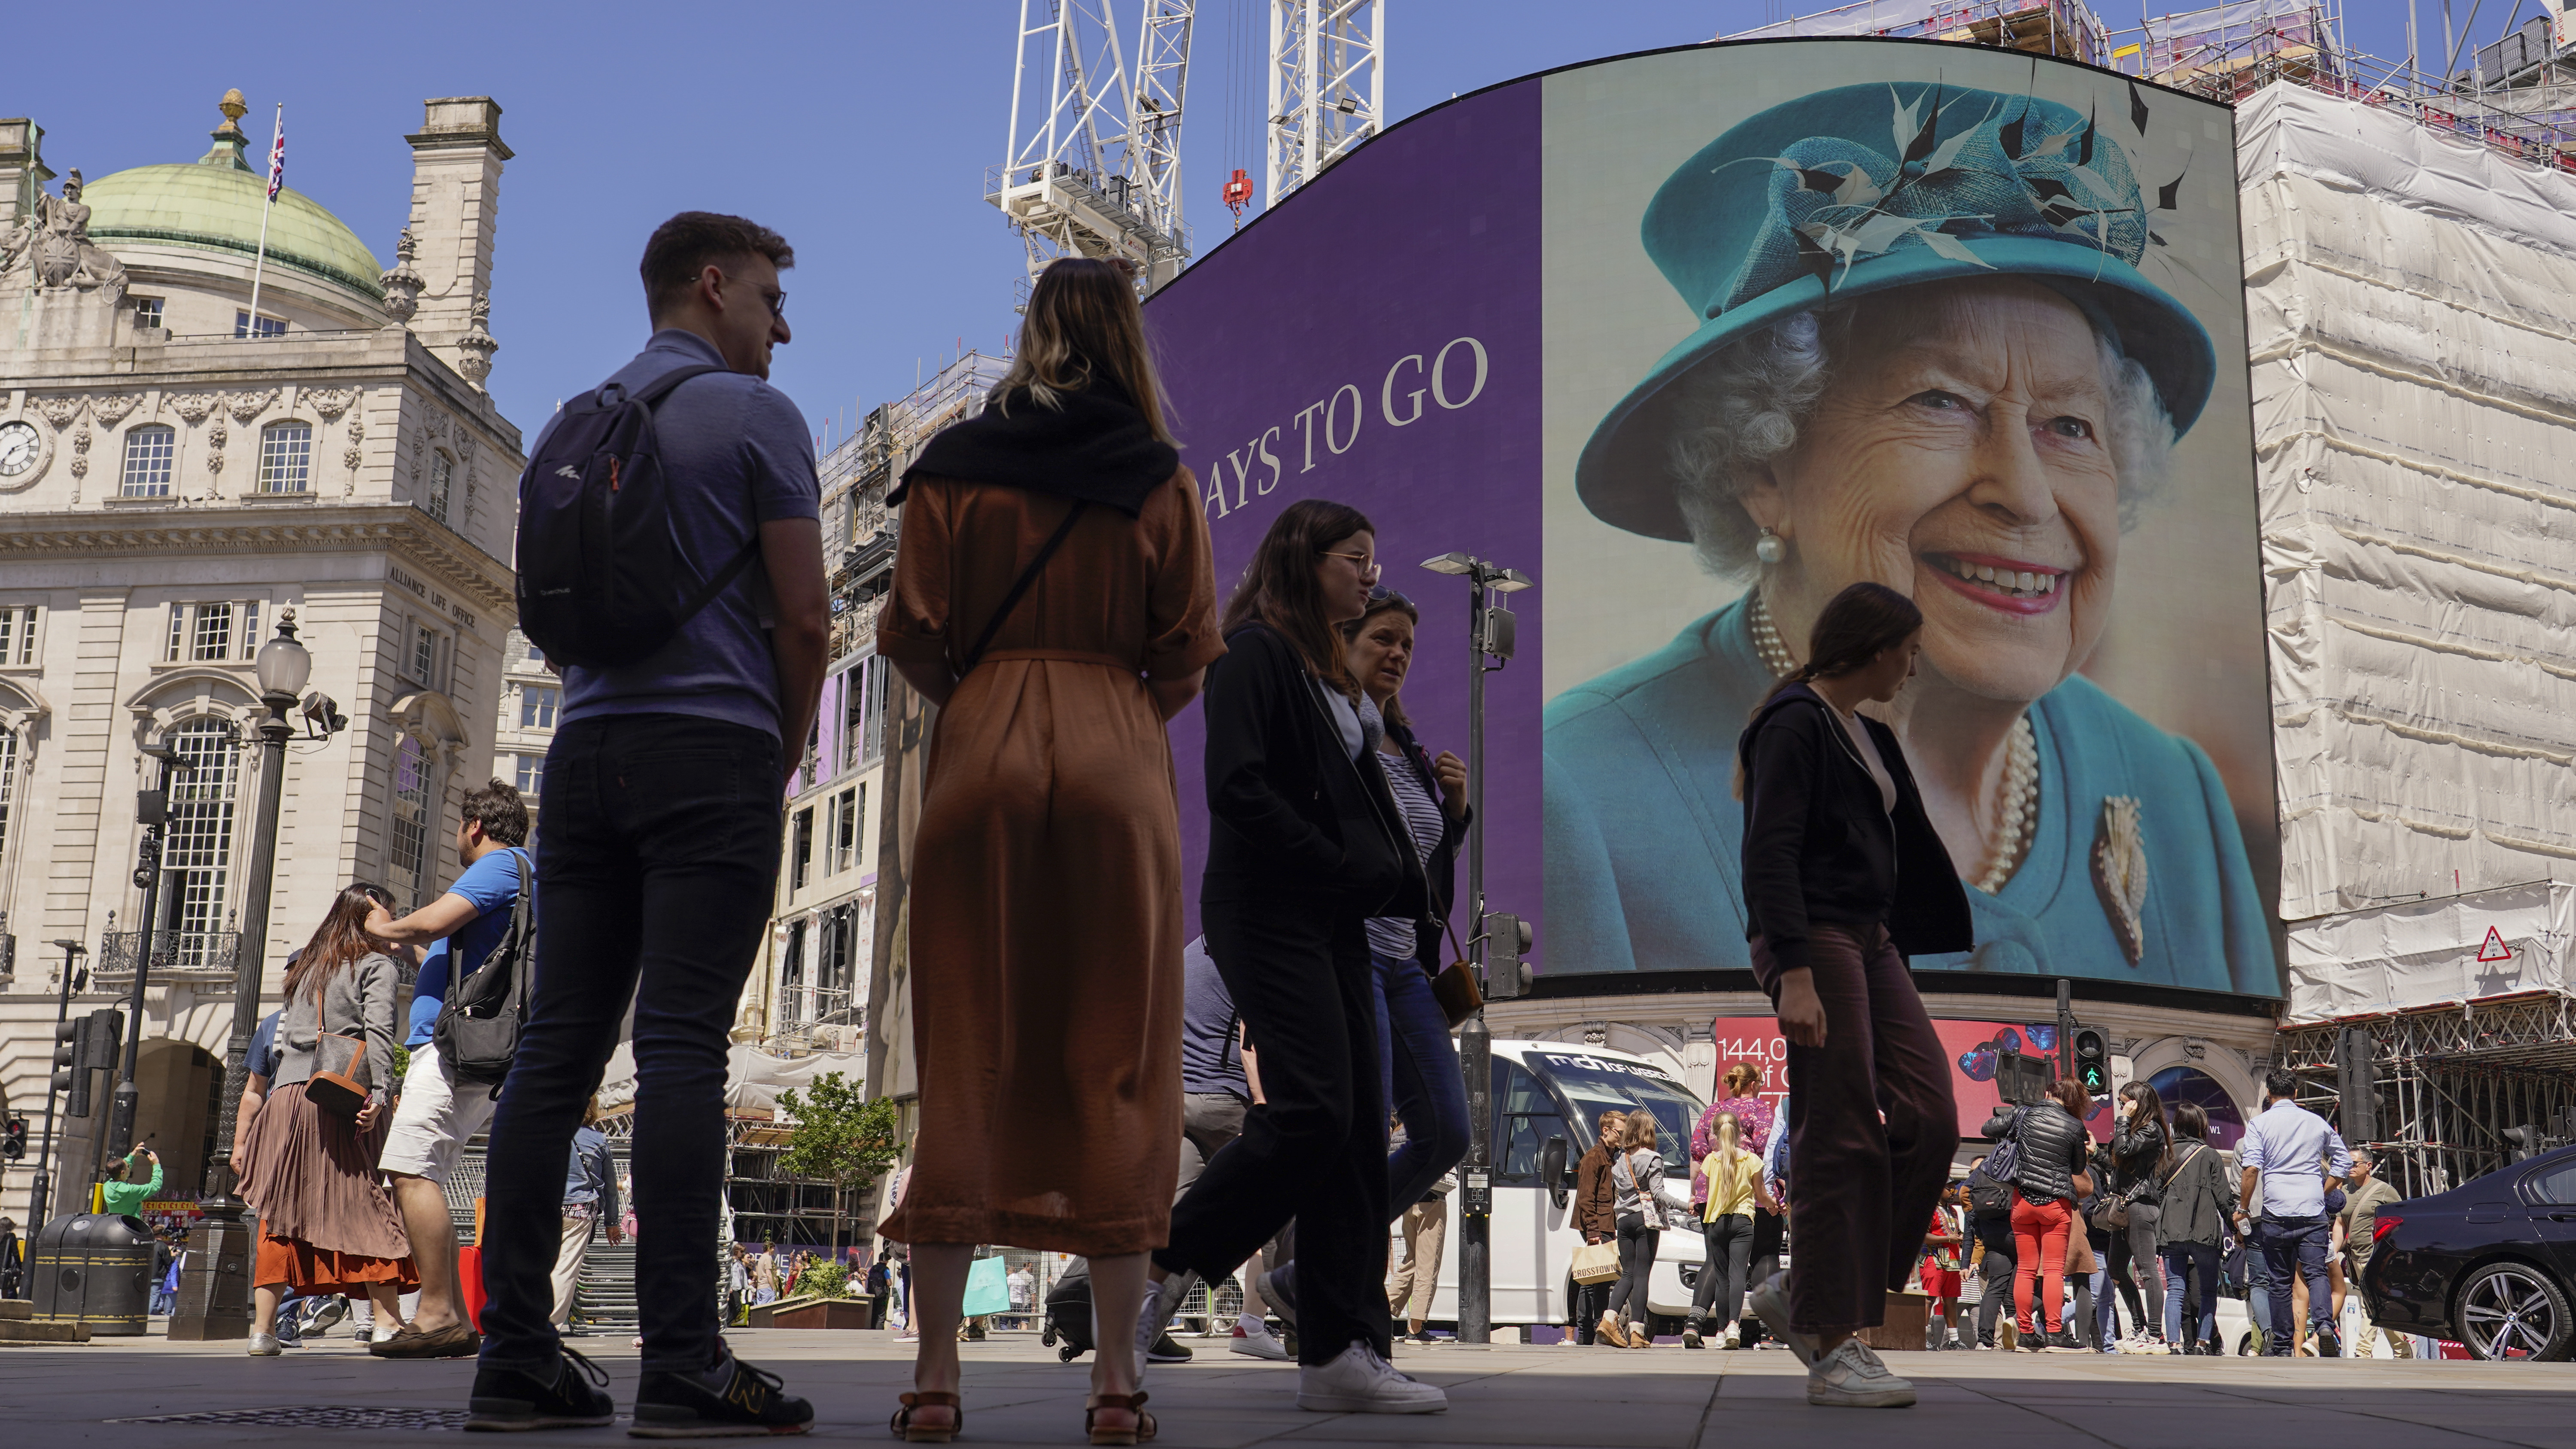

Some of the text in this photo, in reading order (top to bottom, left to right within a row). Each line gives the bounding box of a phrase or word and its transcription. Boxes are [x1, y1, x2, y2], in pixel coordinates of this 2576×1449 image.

[2555, 6, 2564, 35] Select
[1133, 241, 1145, 256] Select
[1195, 337, 1488, 525] AYS TO GO
[390, 566, 475, 628] ALLIANCE LIFE OFFICE
[190, 983, 233, 995] LIFE
[1608, 1062, 1628, 1073] OF
[2209, 1125, 2221, 1134] W1
[1572, 1263, 1616, 1278] CROSSTOWN
